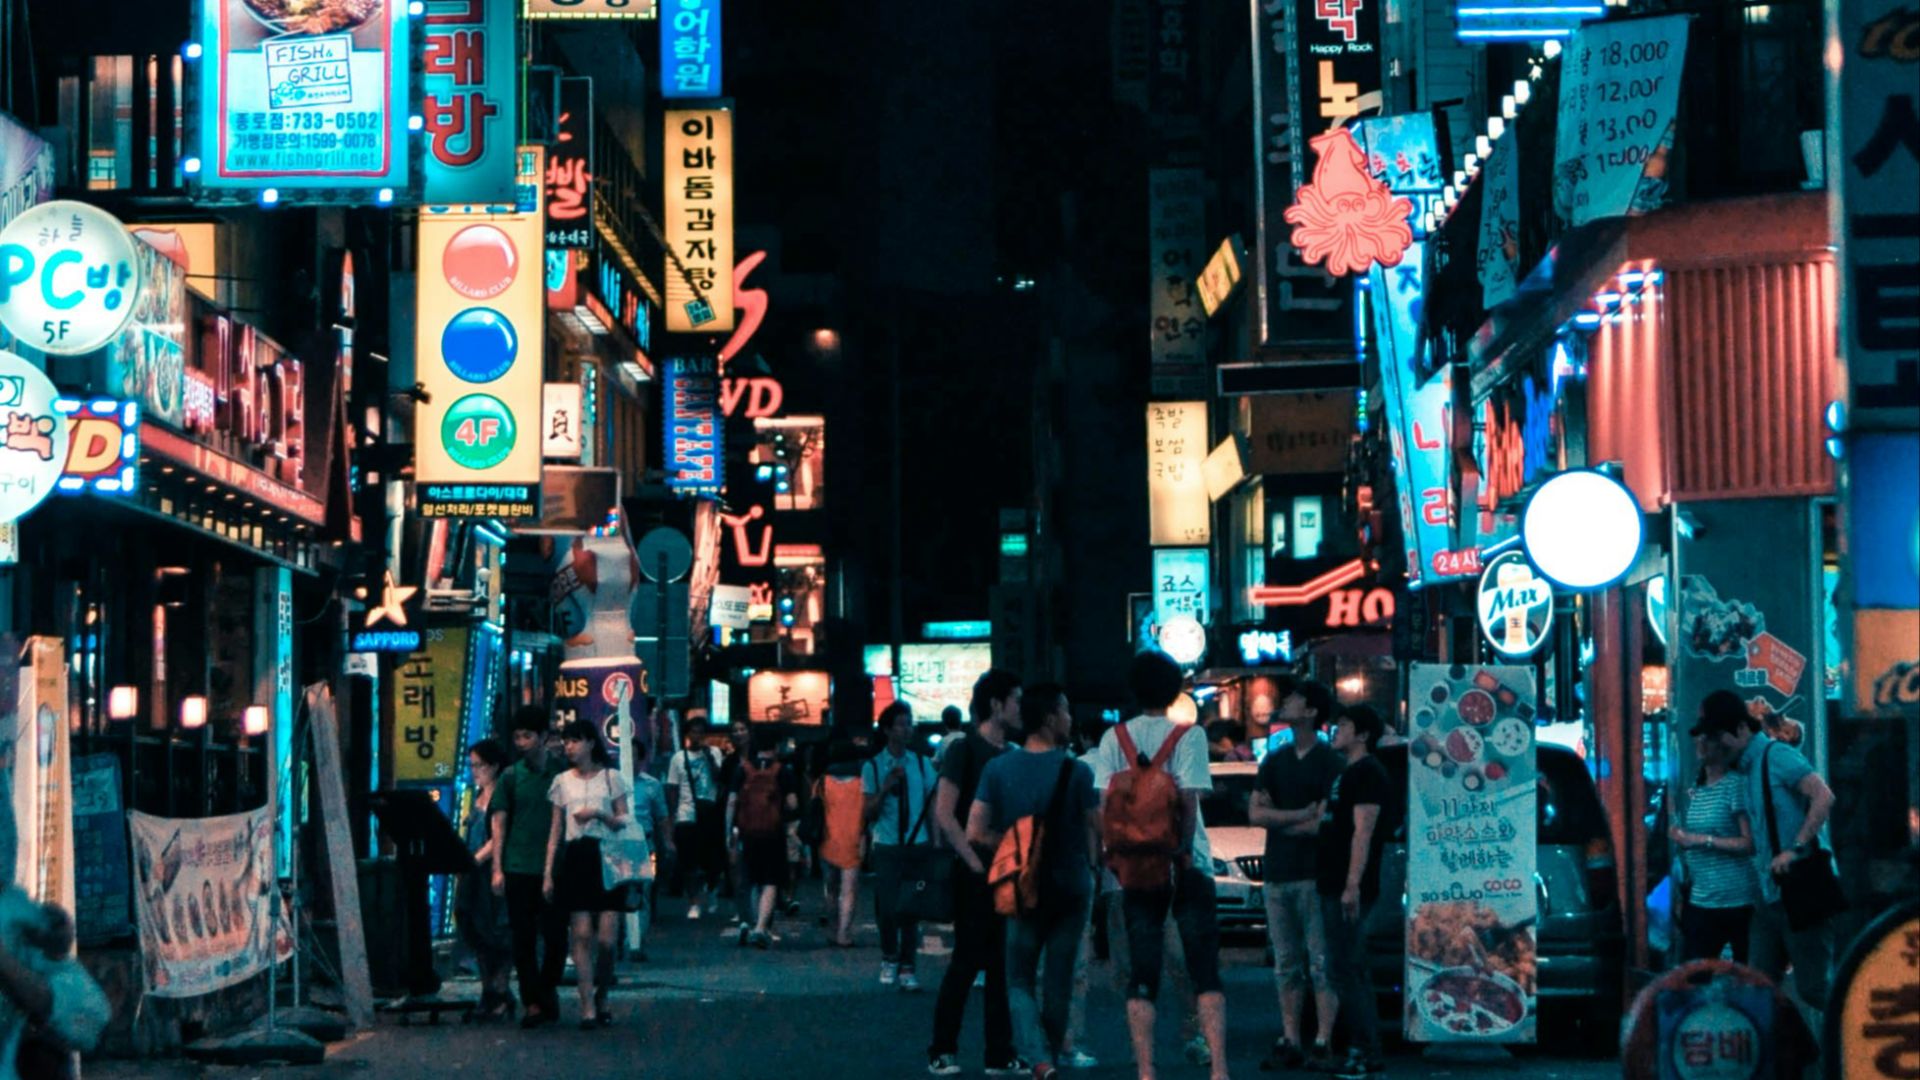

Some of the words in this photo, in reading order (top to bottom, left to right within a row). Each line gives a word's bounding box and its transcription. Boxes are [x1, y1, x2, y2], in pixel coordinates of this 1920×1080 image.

[276, 44, 325, 62] FISH
[1310, 44, 1343, 55] Happy
[1347, 42, 1374, 53] Rock
[1600, 40, 1669, 69] 18,000
[288, 65, 346, 85] GRILL
[43, 321, 70, 344] 5F
[675, 358, 713, 373] BAR
[455, 418, 500, 446] 4F
[1161, 574, 1198, 593] 죠스
[1487, 588, 1538, 620] Max
[355, 631, 420, 649] SAPPORO
